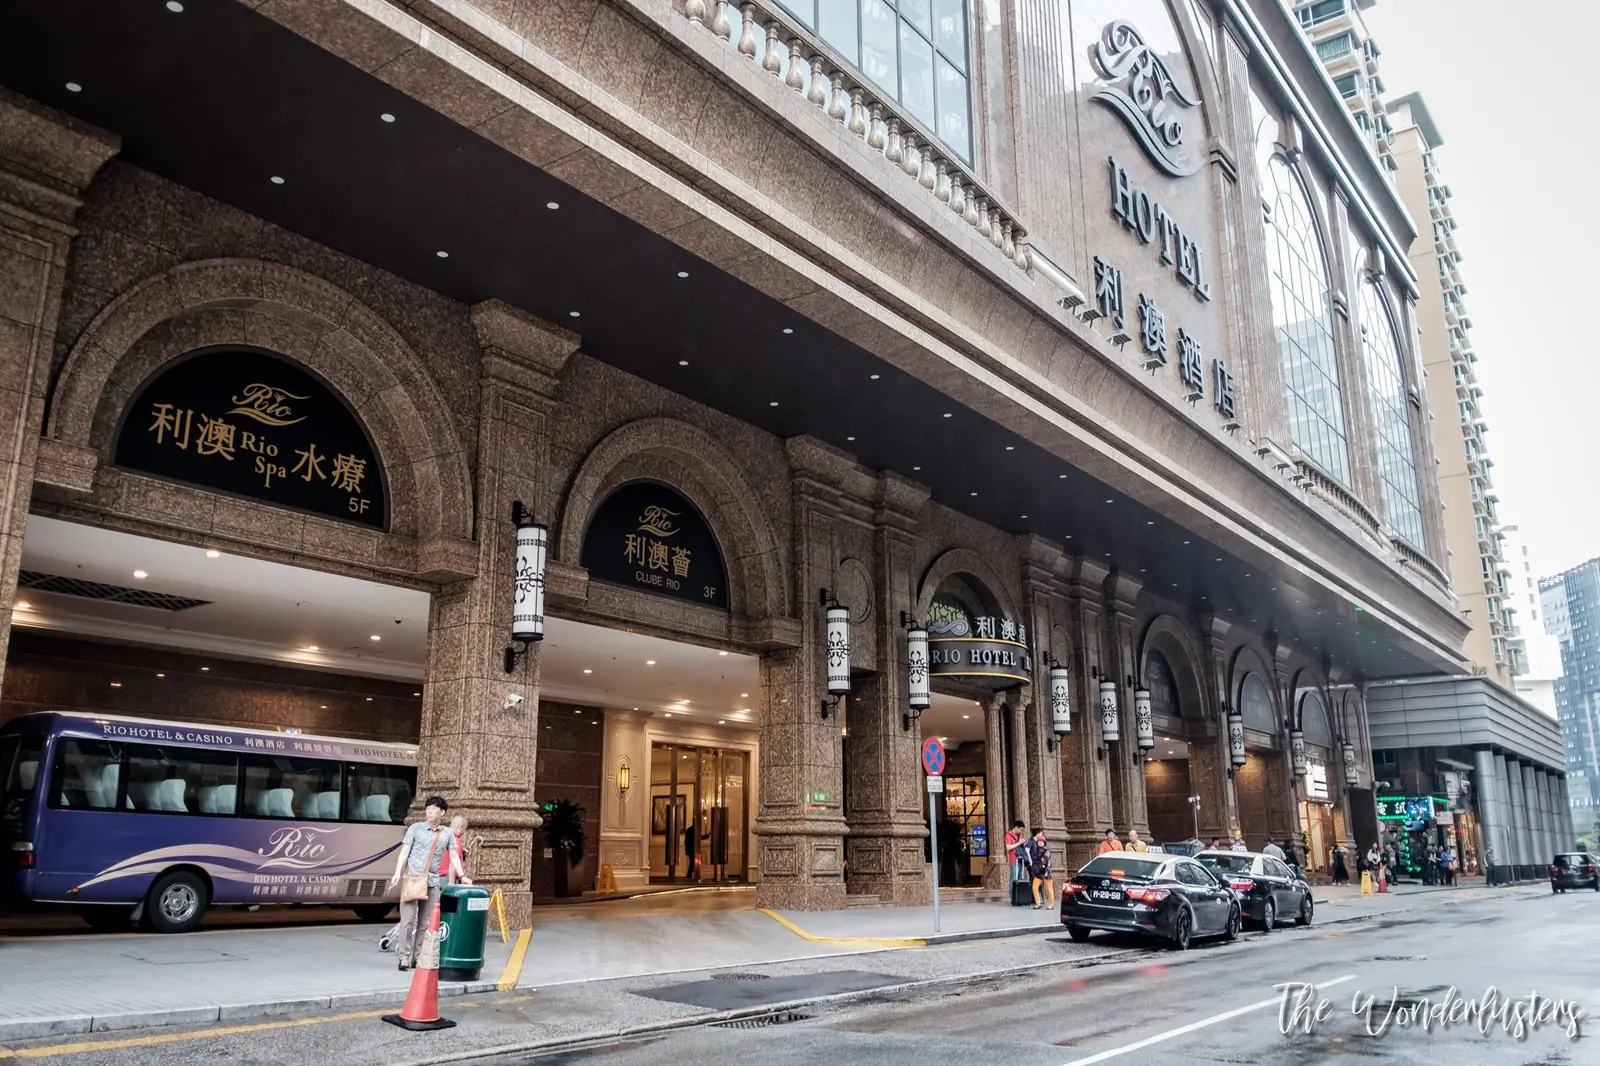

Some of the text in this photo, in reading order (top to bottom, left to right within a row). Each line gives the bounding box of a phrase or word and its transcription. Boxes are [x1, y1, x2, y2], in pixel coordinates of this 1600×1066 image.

[1108, 156, 1211, 302] HOTEL
[1093, 255, 1236, 419] 利澳酒店
[232, 383, 311, 417] Rio
[149, 402, 367, 493] 利澳 水療
[240, 431, 279, 457] Rio
[255, 456, 286, 488] Spa
[349, 497, 370, 514] 5F
[638, 505, 682, 531] Rio
[636, 570, 680, 591] CLUBE RIO
[703, 586, 716, 599] 3F
[931, 649, 961, 664] RIO
[971, 649, 1017, 666] HOTEL
[103, 725, 233, 745] RIO HOTEL & CASINO
[354, 747, 372, 757] RIO
[372, 749, 405, 760] HOTEL
[258, 826, 346, 858] Rio
[254, 875, 339, 884] RIO HOTEL & CASINO
